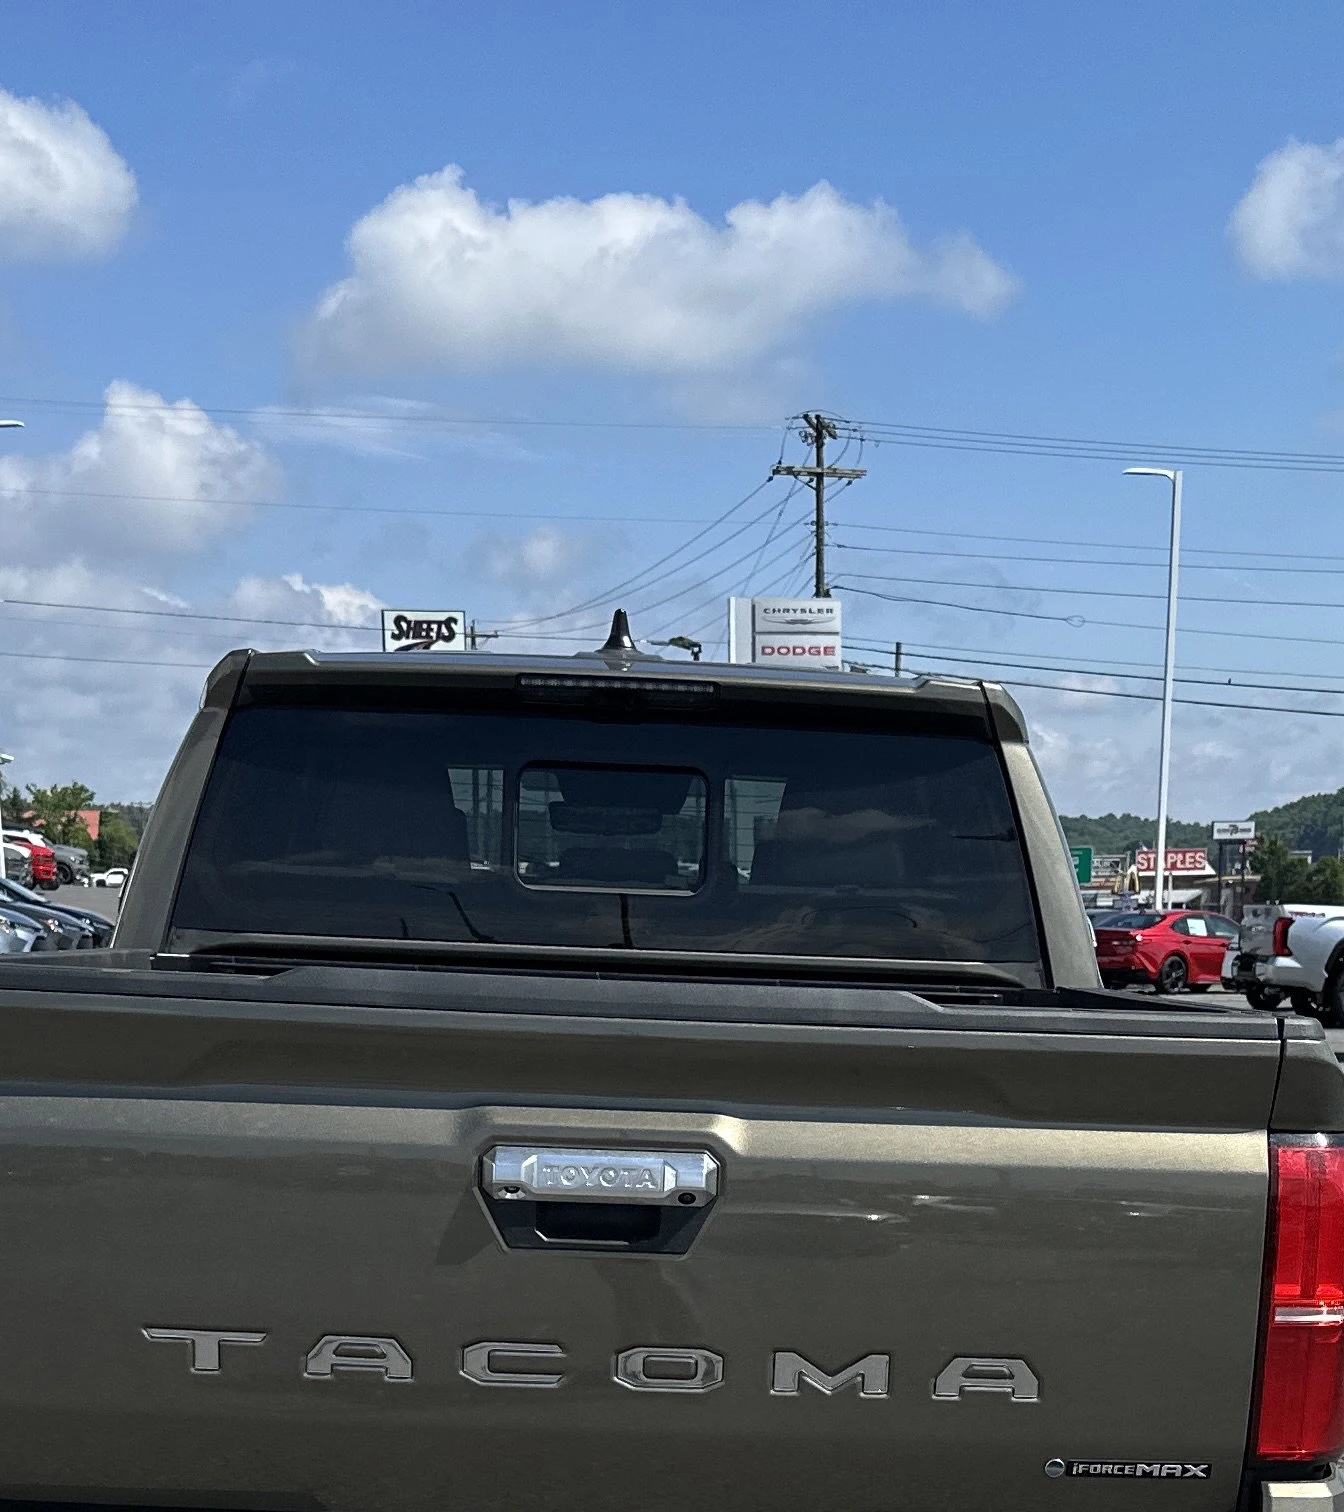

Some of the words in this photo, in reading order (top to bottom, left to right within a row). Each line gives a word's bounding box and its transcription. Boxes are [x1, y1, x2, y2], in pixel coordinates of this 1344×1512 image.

[763, 607, 834, 615] CHRYSLER
[761, 645, 836, 656] DODGE
[1137, 852, 1206, 870] STPLES
[542, 1164, 657, 1189] TOYOTA
[141, 1326, 1042, 1402] TACOMA
